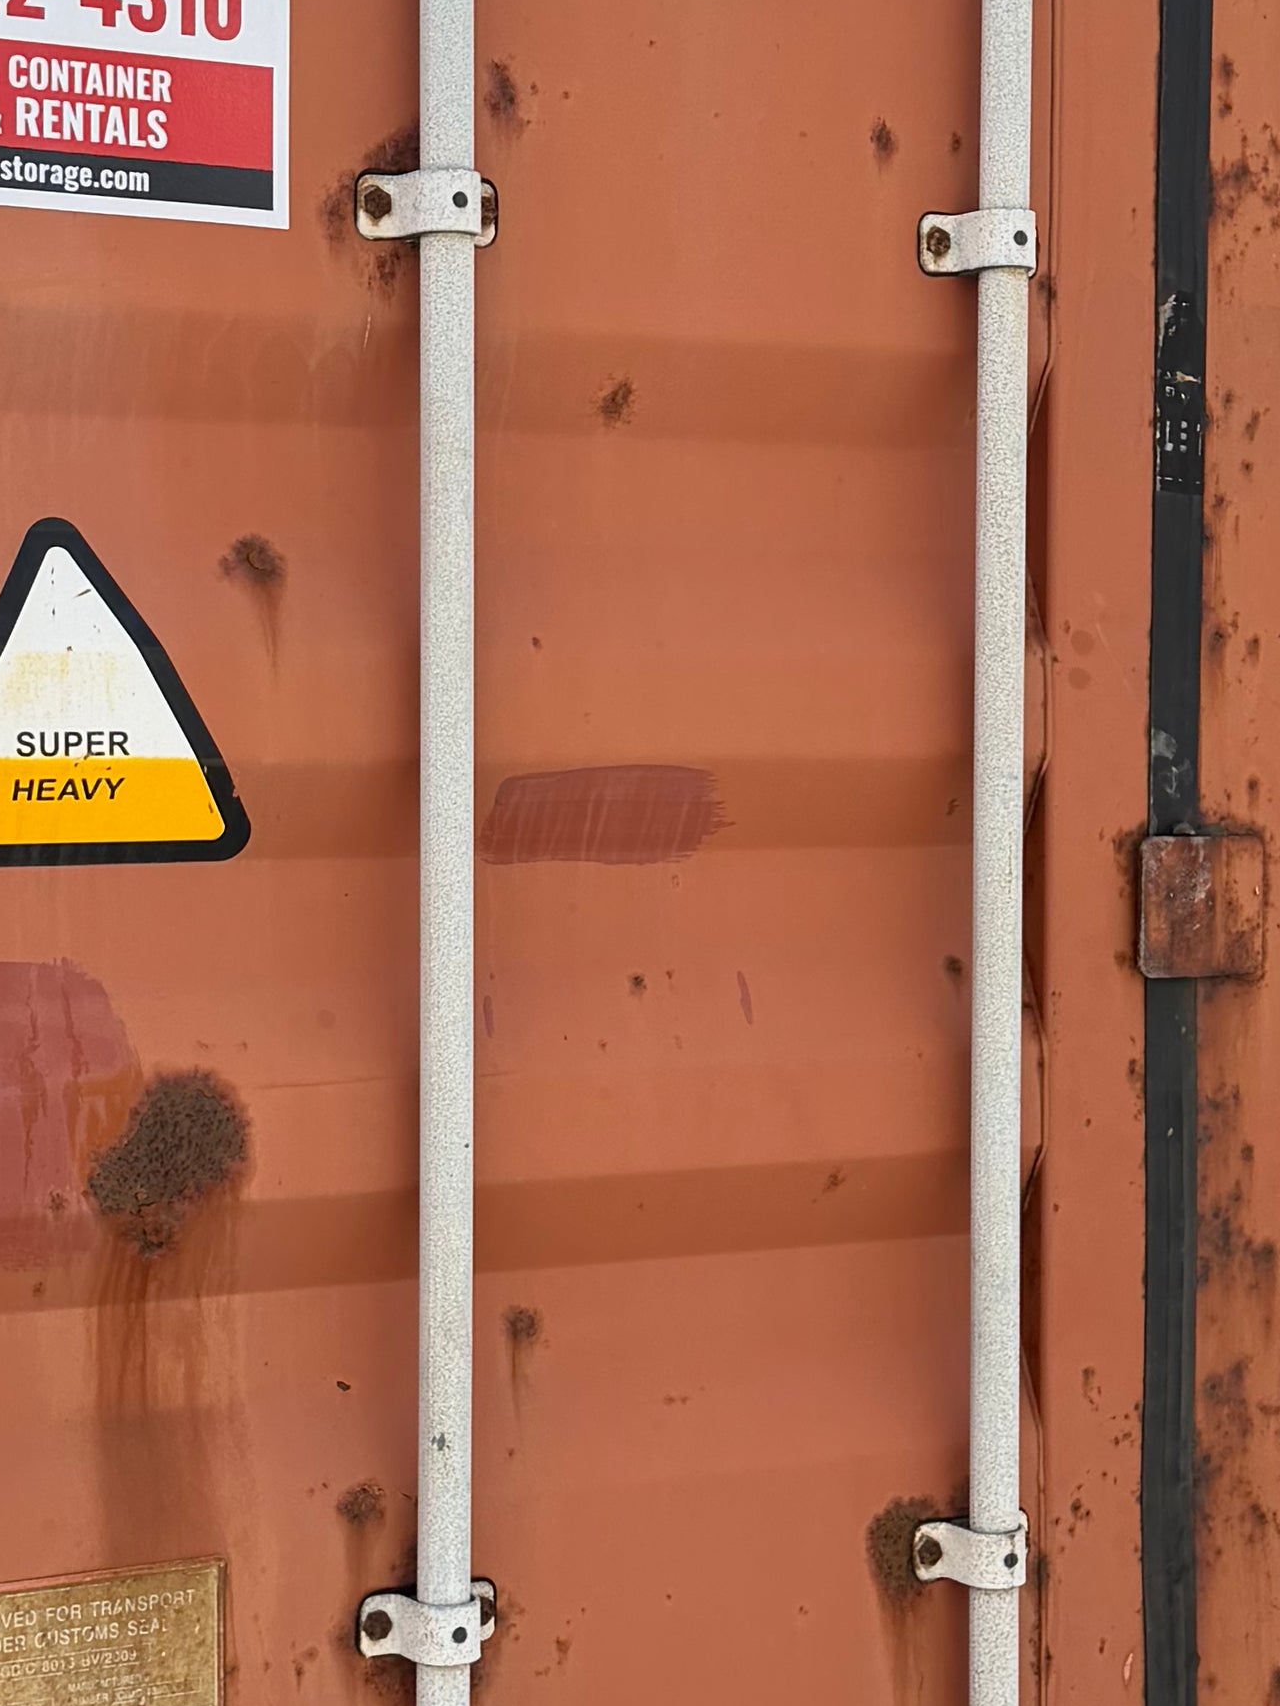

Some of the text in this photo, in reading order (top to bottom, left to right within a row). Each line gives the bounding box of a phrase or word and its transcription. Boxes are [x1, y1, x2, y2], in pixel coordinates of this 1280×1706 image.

[7, 53, 173, 104] CONTAINER
[15, 98, 169, 150] RENTALS
[15, 731, 130, 756] SUPER
[11, 777, 125, 802] HEAVY
[45, 1604, 83, 1623] FOR
[90, 1589, 196, 1619] TRANSPORT
[34, 1622, 120, 1650] CUSTOMS
[127, 1617, 169, 1637] SEAL
